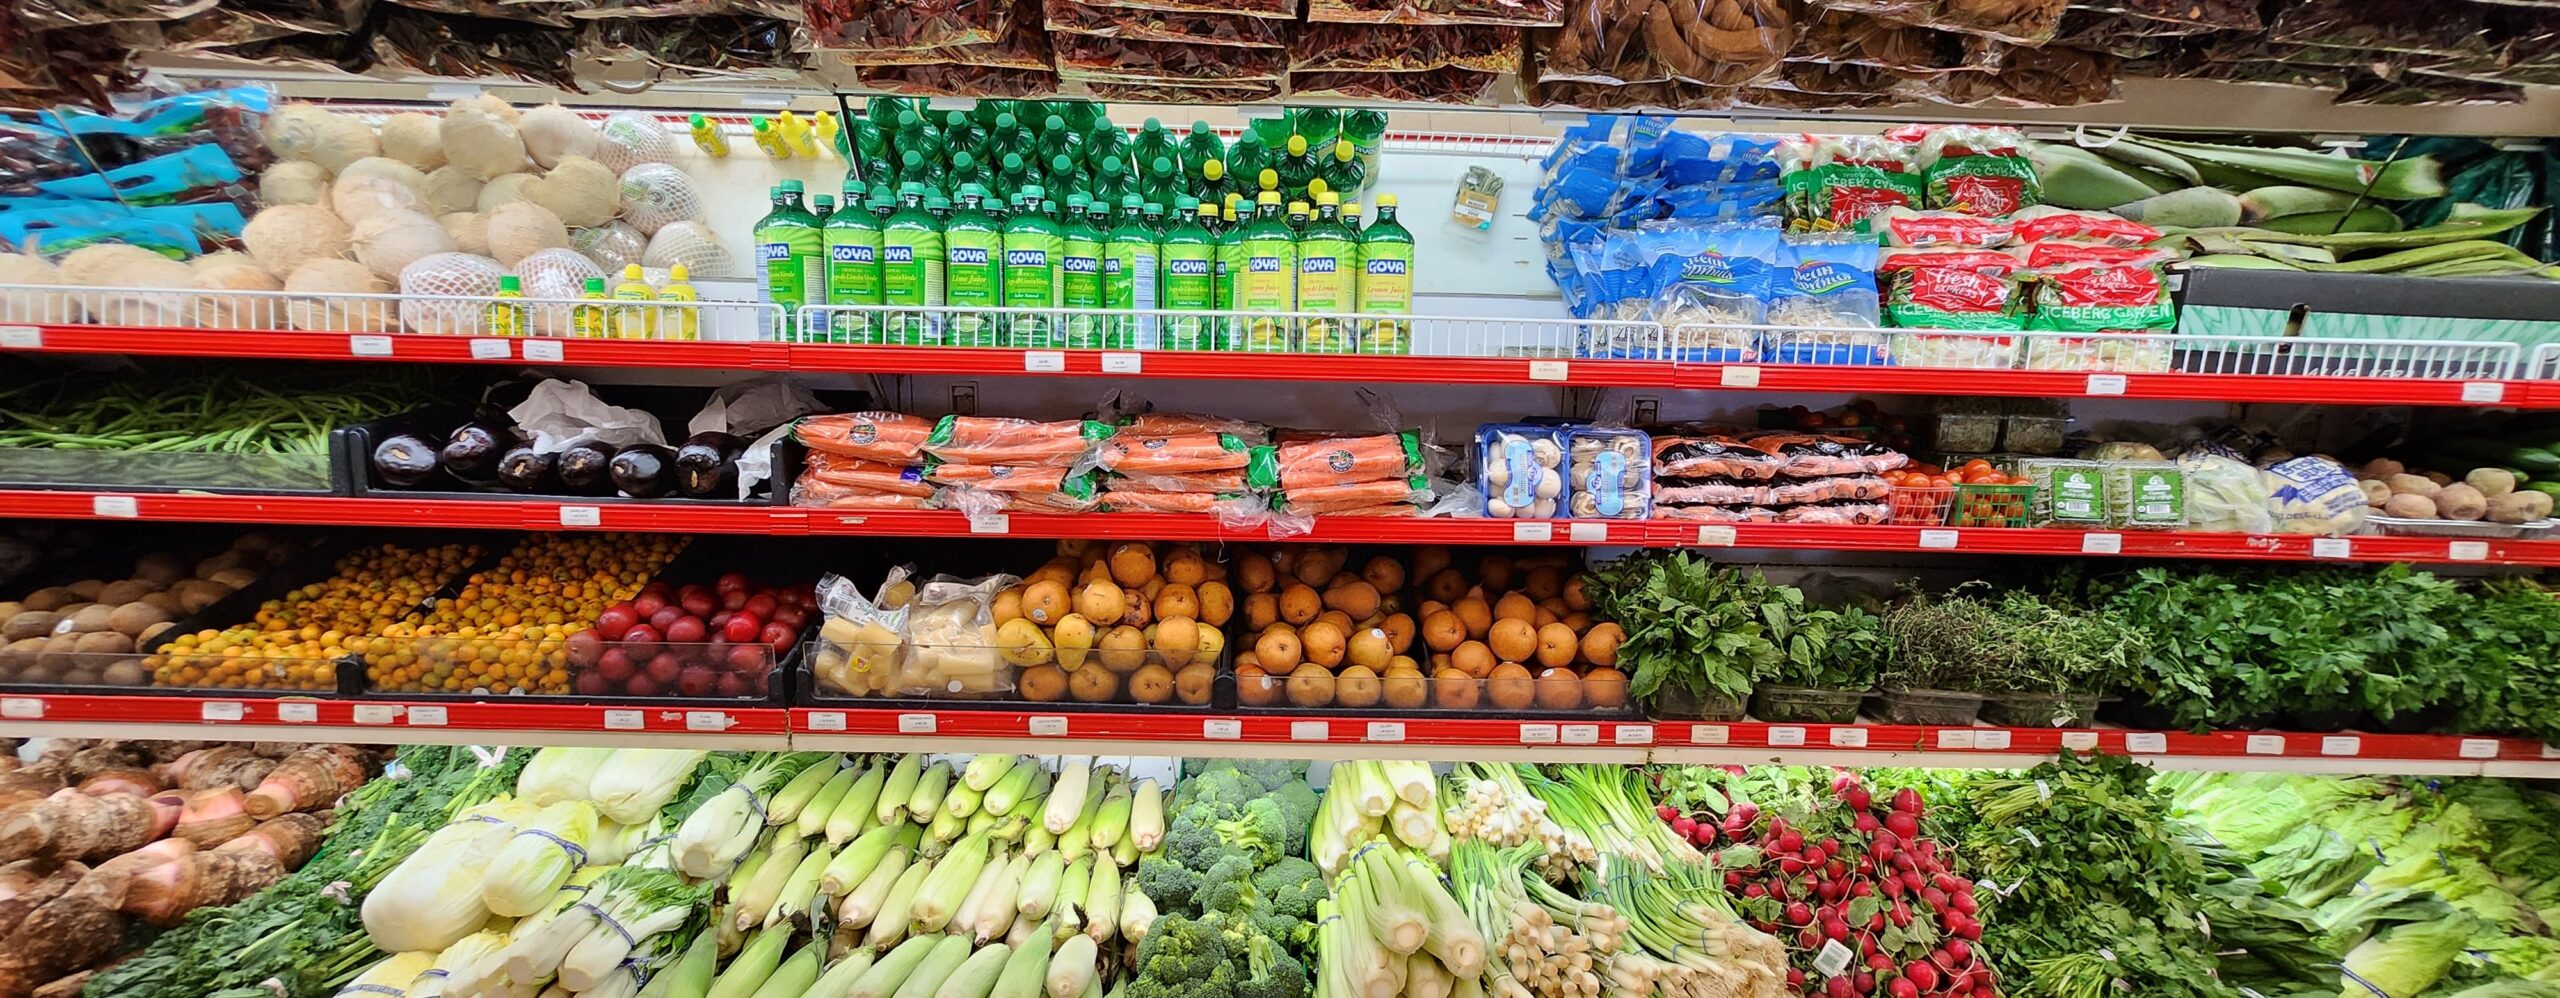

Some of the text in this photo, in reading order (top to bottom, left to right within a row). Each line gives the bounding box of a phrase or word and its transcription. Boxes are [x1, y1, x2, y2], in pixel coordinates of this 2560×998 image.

[833, 247, 873, 262] GOYA
[885, 247, 911, 261] OYA
[951, 250, 987, 263] GOYA
[1008, 252, 1045, 265] GOYA
[1065, 259, 1096, 272] GOYA
[1171, 262, 1207, 274] GOYA
[1250, 259, 1279, 272] GOYA
[1303, 259, 1336, 272] GOYA
[1368, 261, 1405, 274] GOYA
[1935, 268, 1982, 290] fresh
[1934, 283, 1978, 299] EXPRESS
